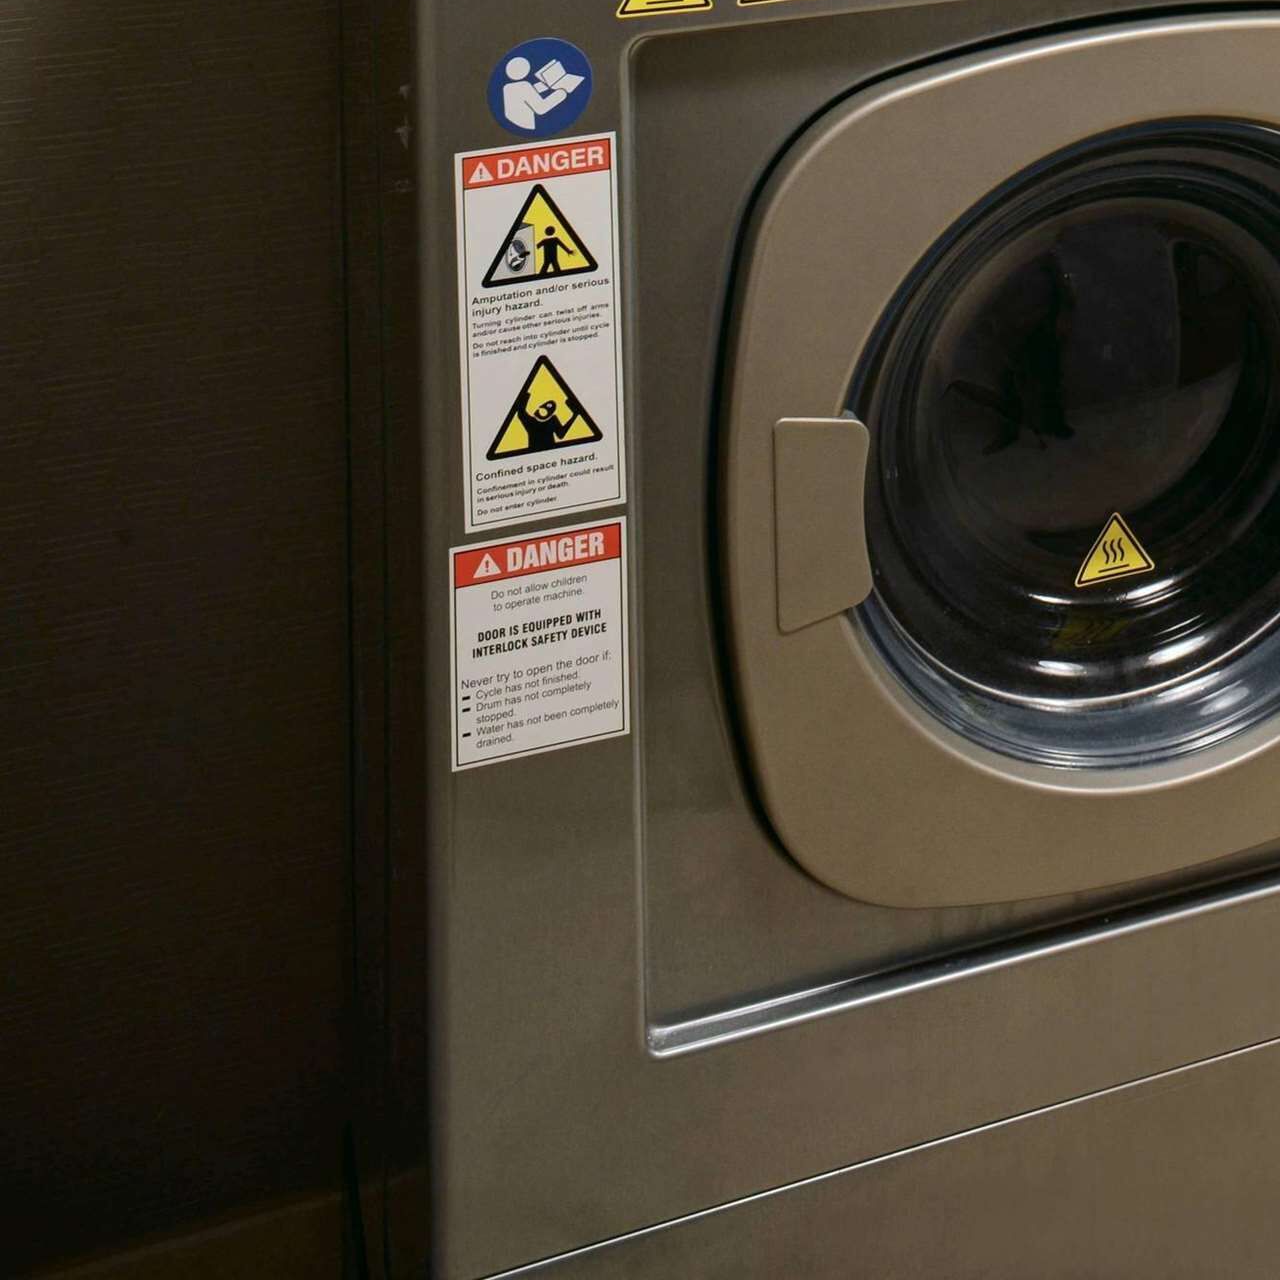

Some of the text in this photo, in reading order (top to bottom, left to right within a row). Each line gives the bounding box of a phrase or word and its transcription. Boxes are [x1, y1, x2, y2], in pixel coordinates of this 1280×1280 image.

[497, 145, 604, 180] DANGER
[471, 277, 610, 306] Amputation and/or serious
[471, 301, 503, 318] injury
[475, 464, 524, 482] Confined
[526, 460, 557, 474] space
[507, 531, 605, 572] DANGER
[491, 574, 588, 600] Do not allow children
[493, 602, 503, 612] to
[505, 596, 541, 611] operate
[472, 622, 607, 659] INTERLOCK SAFETY DEVICE
[477, 608, 602, 643] DOOR IS EQUIPPED WITH
[461, 675, 494, 690] Never
[496, 670, 511, 683] try
[513, 669, 524, 679] to
[526, 663, 554, 678] open
[556, 657, 573, 671] the
[575, 653, 600, 667] door
[475, 686, 503, 700] Cycle
[505, 682, 522, 694] has
[524, 679, 540, 690] not
[475, 681, 593, 712] Drum has not completely
[475, 699, 620, 737] Water has not been completely
